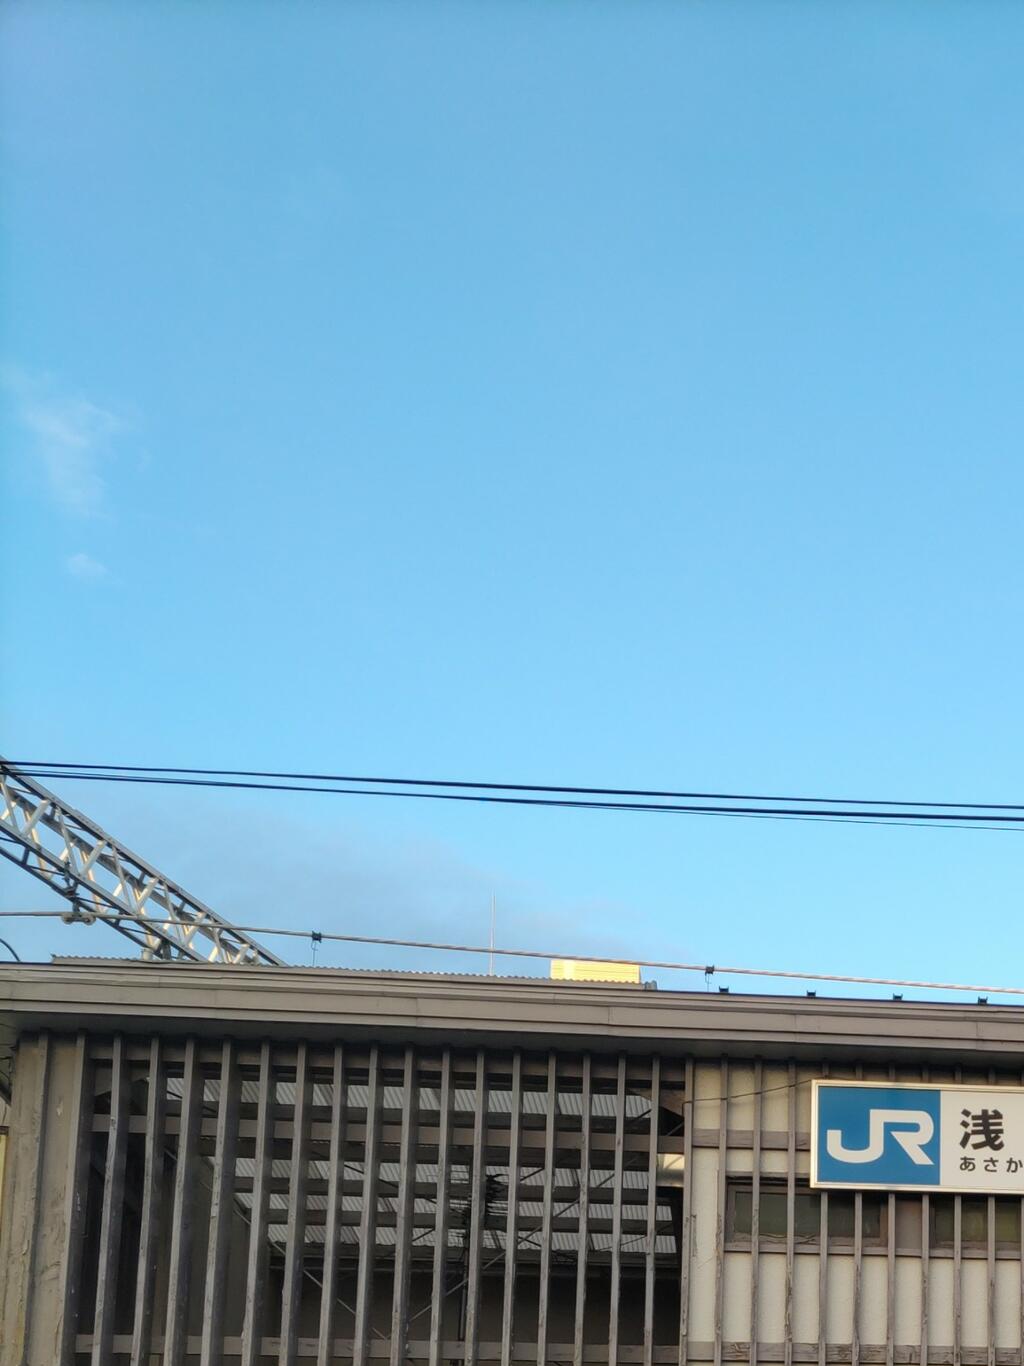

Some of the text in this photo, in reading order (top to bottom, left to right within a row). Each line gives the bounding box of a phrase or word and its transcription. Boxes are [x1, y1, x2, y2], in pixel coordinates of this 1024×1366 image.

[826, 1109, 934, 1166] JR
[959, 1156, 1024, 1174] あさか
